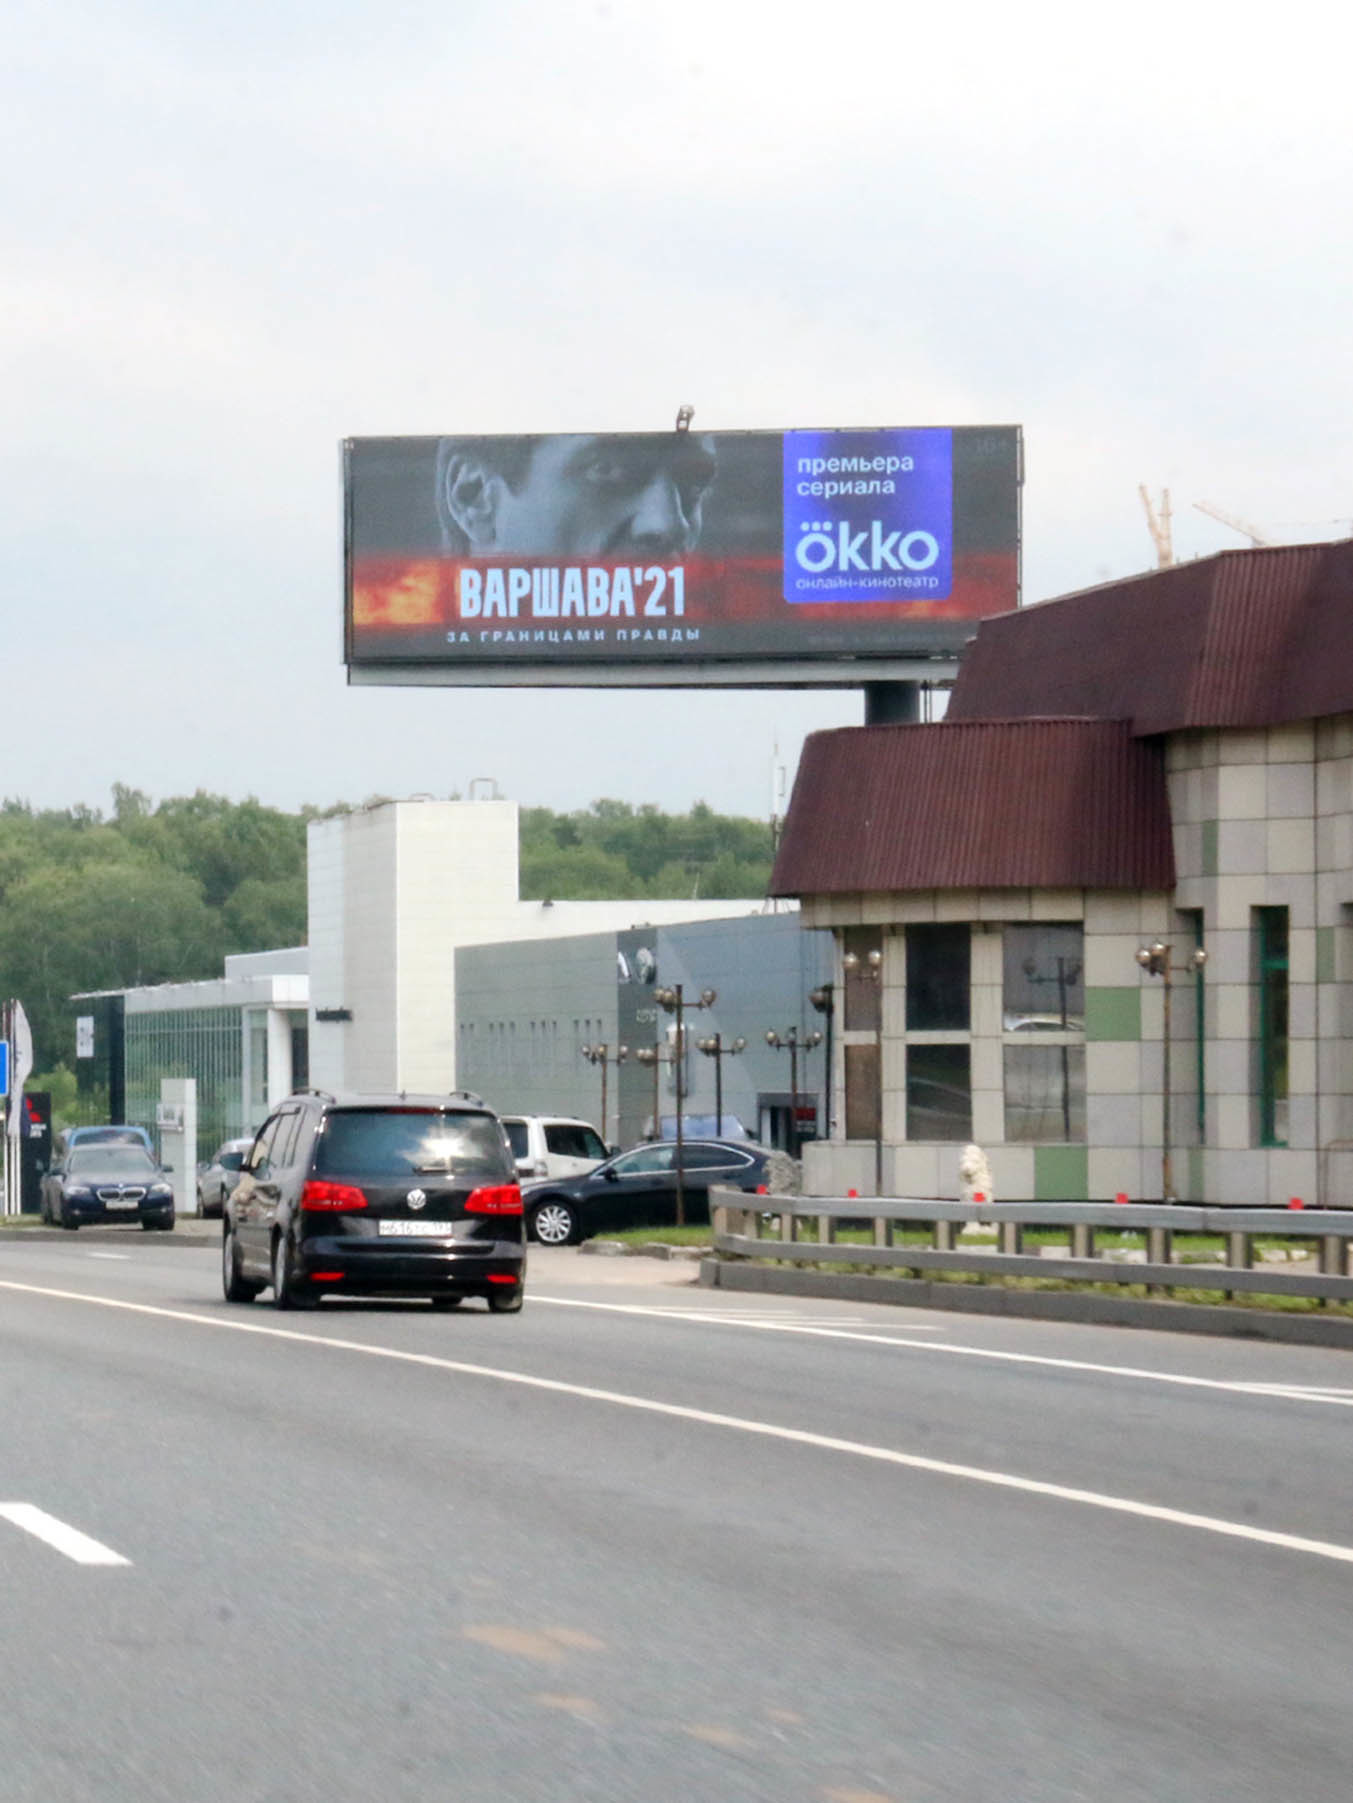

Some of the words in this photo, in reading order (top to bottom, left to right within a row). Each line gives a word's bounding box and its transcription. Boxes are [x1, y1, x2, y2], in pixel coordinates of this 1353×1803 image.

[797, 456, 915, 476] премьера
[796, 479, 896, 499] сериала
[459, 566, 685, 618] ВАРШАВА'21
[795, 575, 939, 589] онлайн-кинотеатр
[447, 631, 471, 643] ЗА
[480, 629, 605, 643] ГРАНИЦАМИ
[616, 628, 701, 642] ПРАВДЫ
